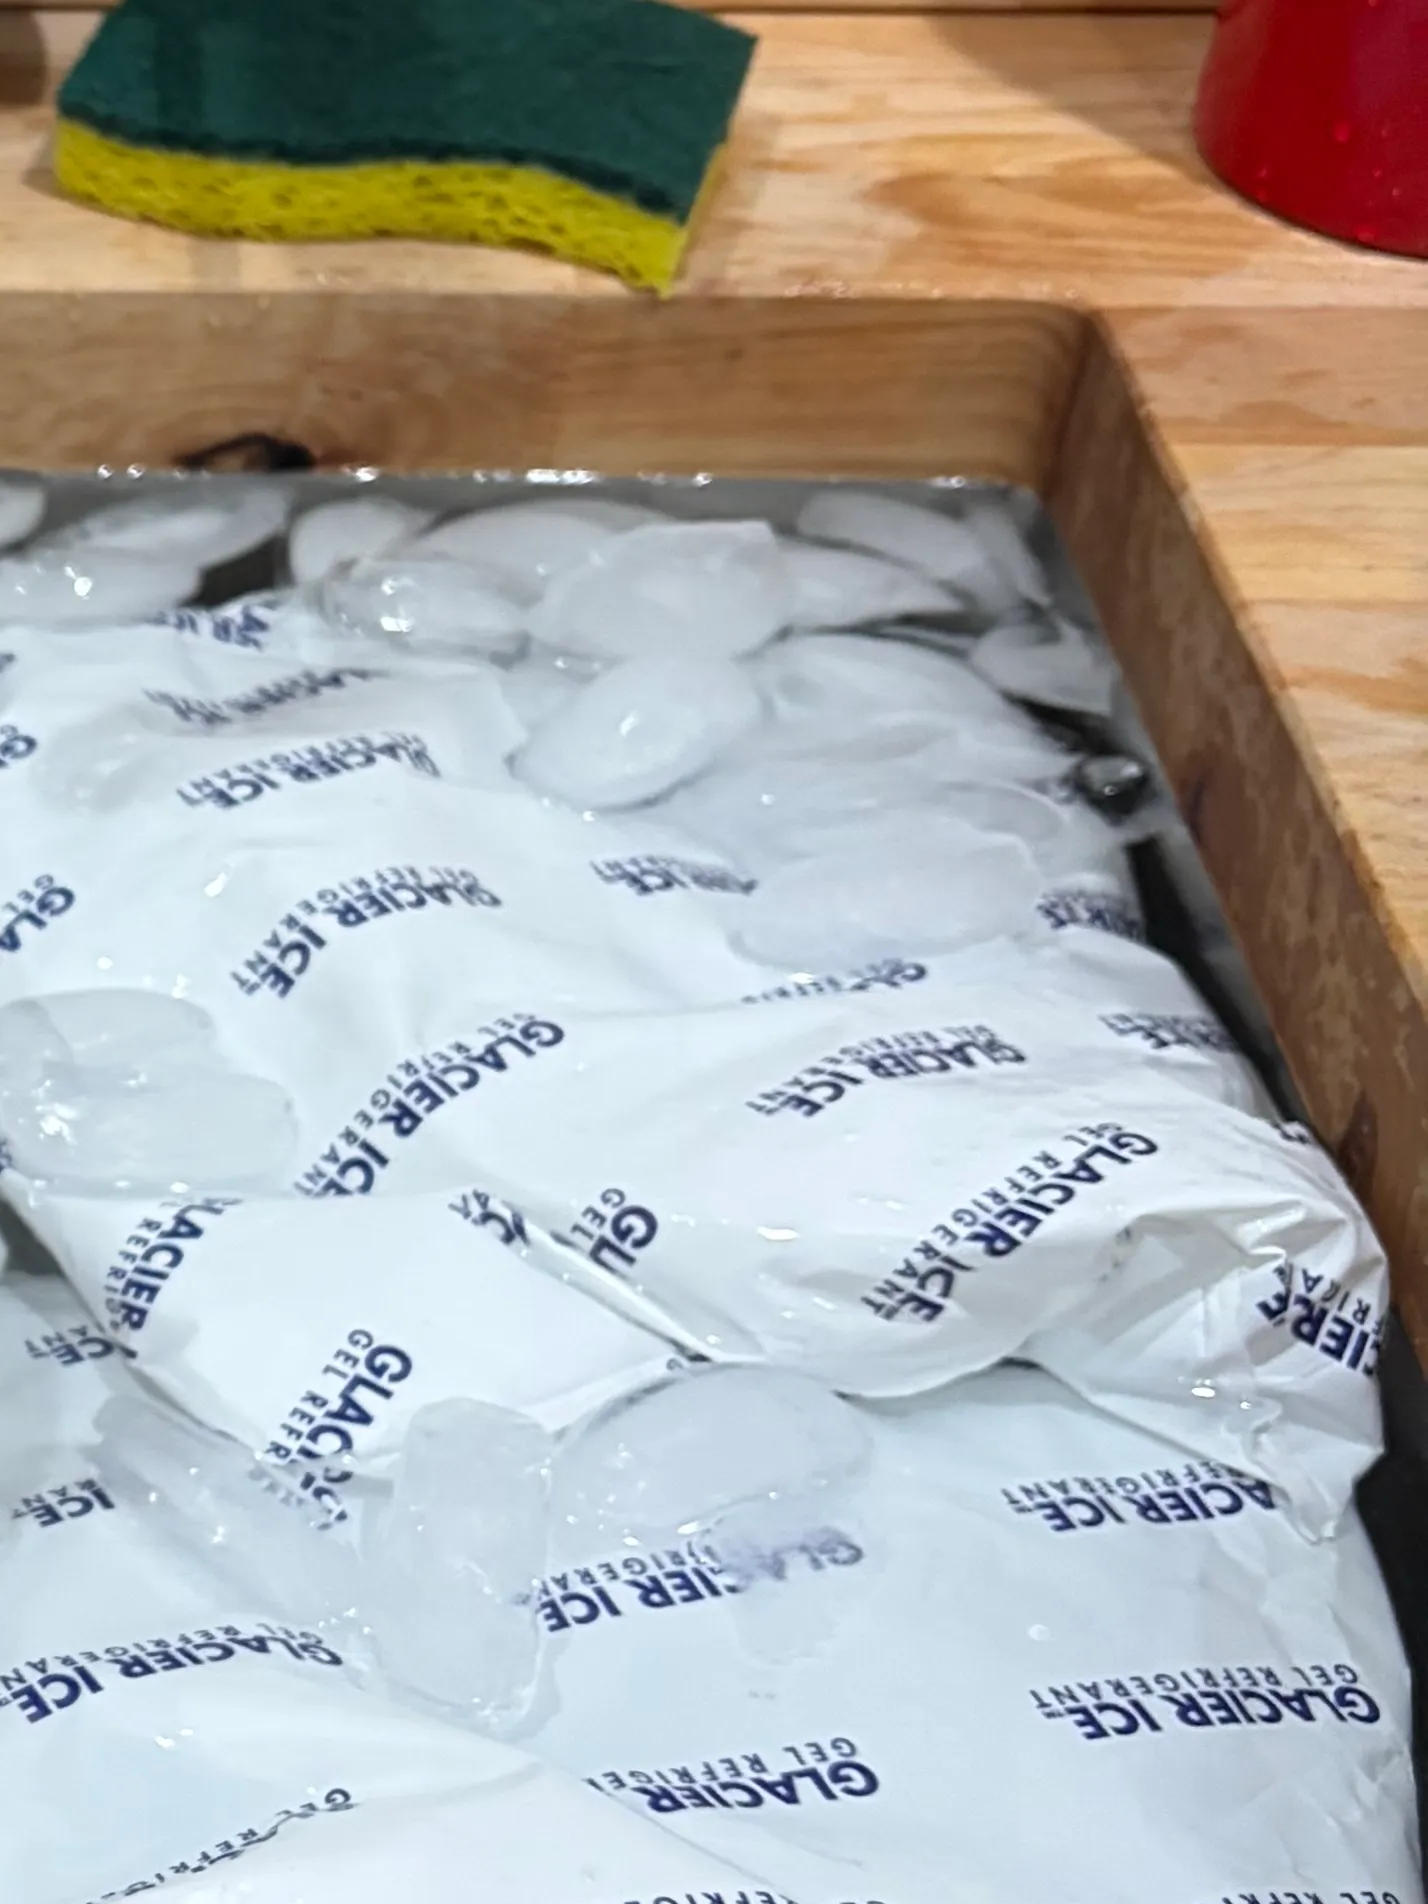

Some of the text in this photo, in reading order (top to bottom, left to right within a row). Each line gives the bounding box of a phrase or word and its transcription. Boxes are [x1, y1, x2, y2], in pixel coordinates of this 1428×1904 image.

[321, 881, 503, 928] GLACIER
[378, 1020, 565, 1138] GLACIER
[964, 1131, 1159, 1257] GLACIER
[860, 1150, 1063, 1315] REFRIGERANT
[120, 1197, 244, 1331] LACIER
[321, 1328, 374, 1380] GEL
[29, 1486, 115, 1528] ICE
[1121, 1480, 1277, 1524] ACIER
[538, 1585, 622, 1633] ICE
[106, 1633, 345, 1679] GLACIER
[1029, 1663, 1359, 1709] GEL REFRIGERANT
[1156, 1686, 1382, 1728] GLACIER
[782, 1737, 858, 1766] GEL
[630, 1759, 880, 1814] GLACIER
